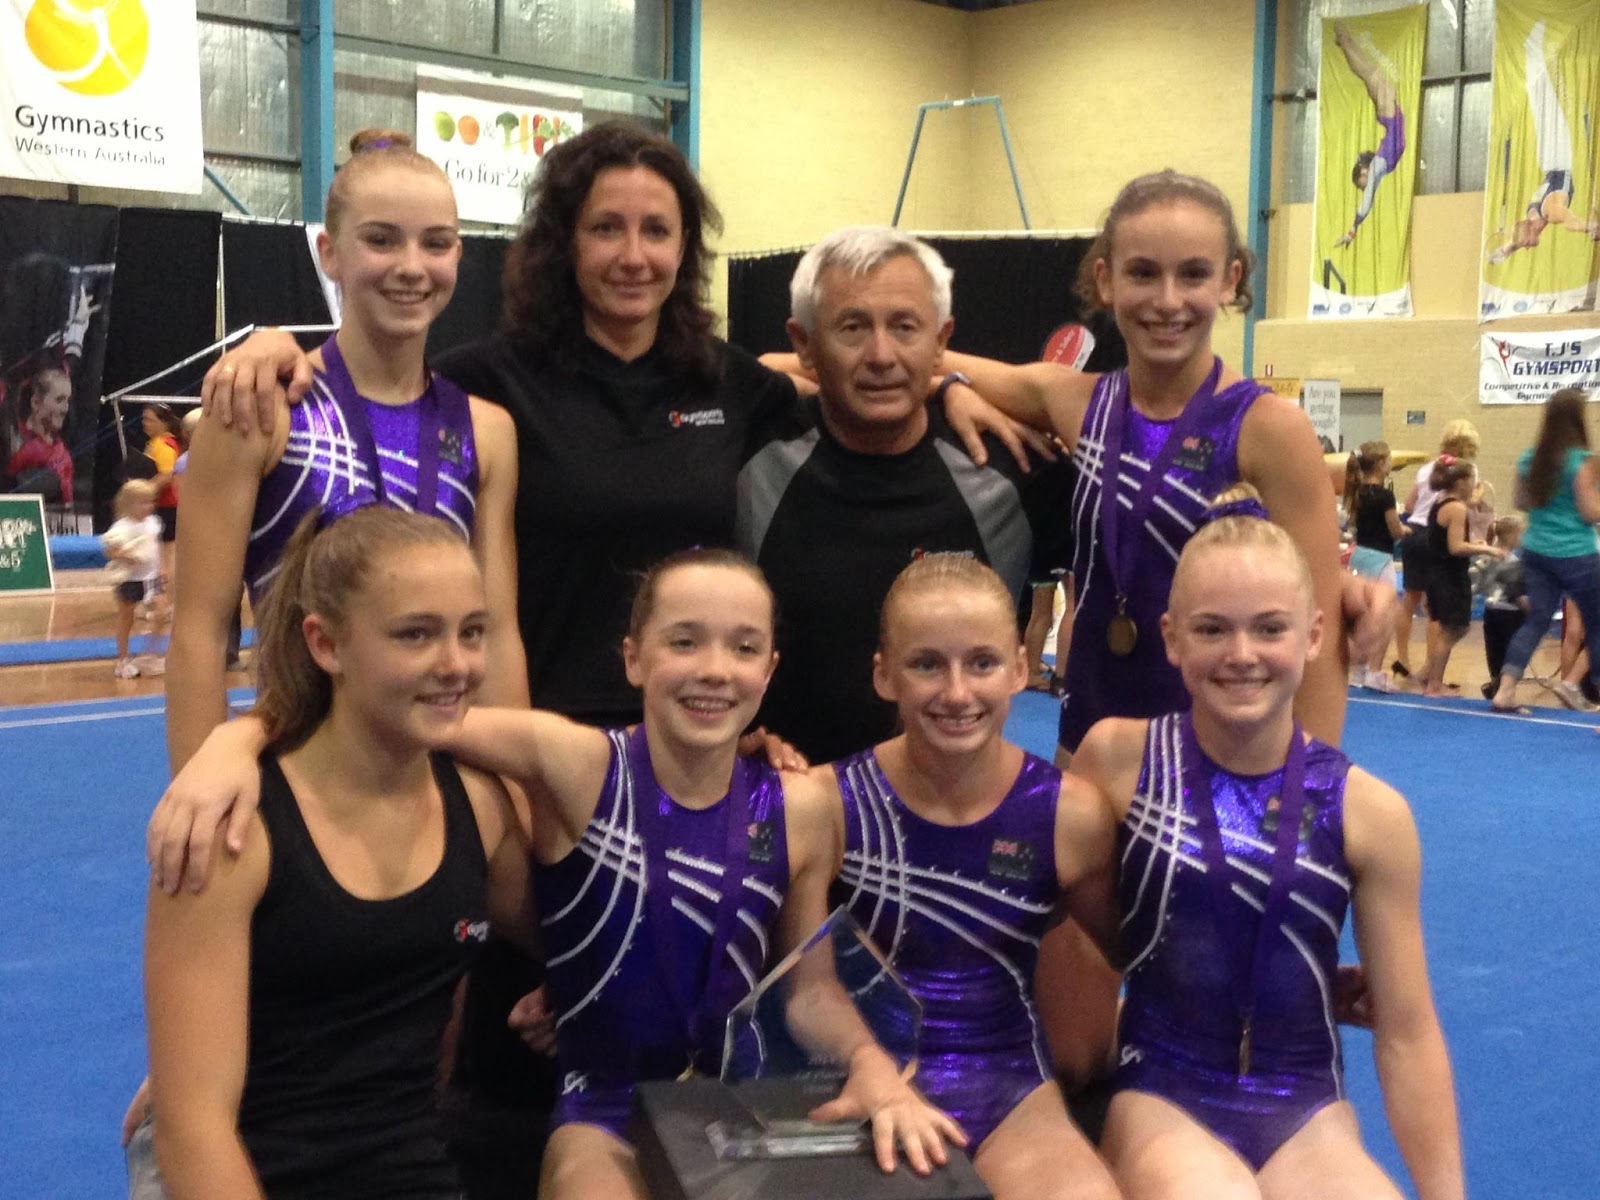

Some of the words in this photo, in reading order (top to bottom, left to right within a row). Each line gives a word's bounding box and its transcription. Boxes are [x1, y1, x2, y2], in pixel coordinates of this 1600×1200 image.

[15, 104, 165, 142] Gymnastics
[15, 136, 87, 159] Western
[95, 147, 165, 166] Australia
[478, 162, 504, 187] for
